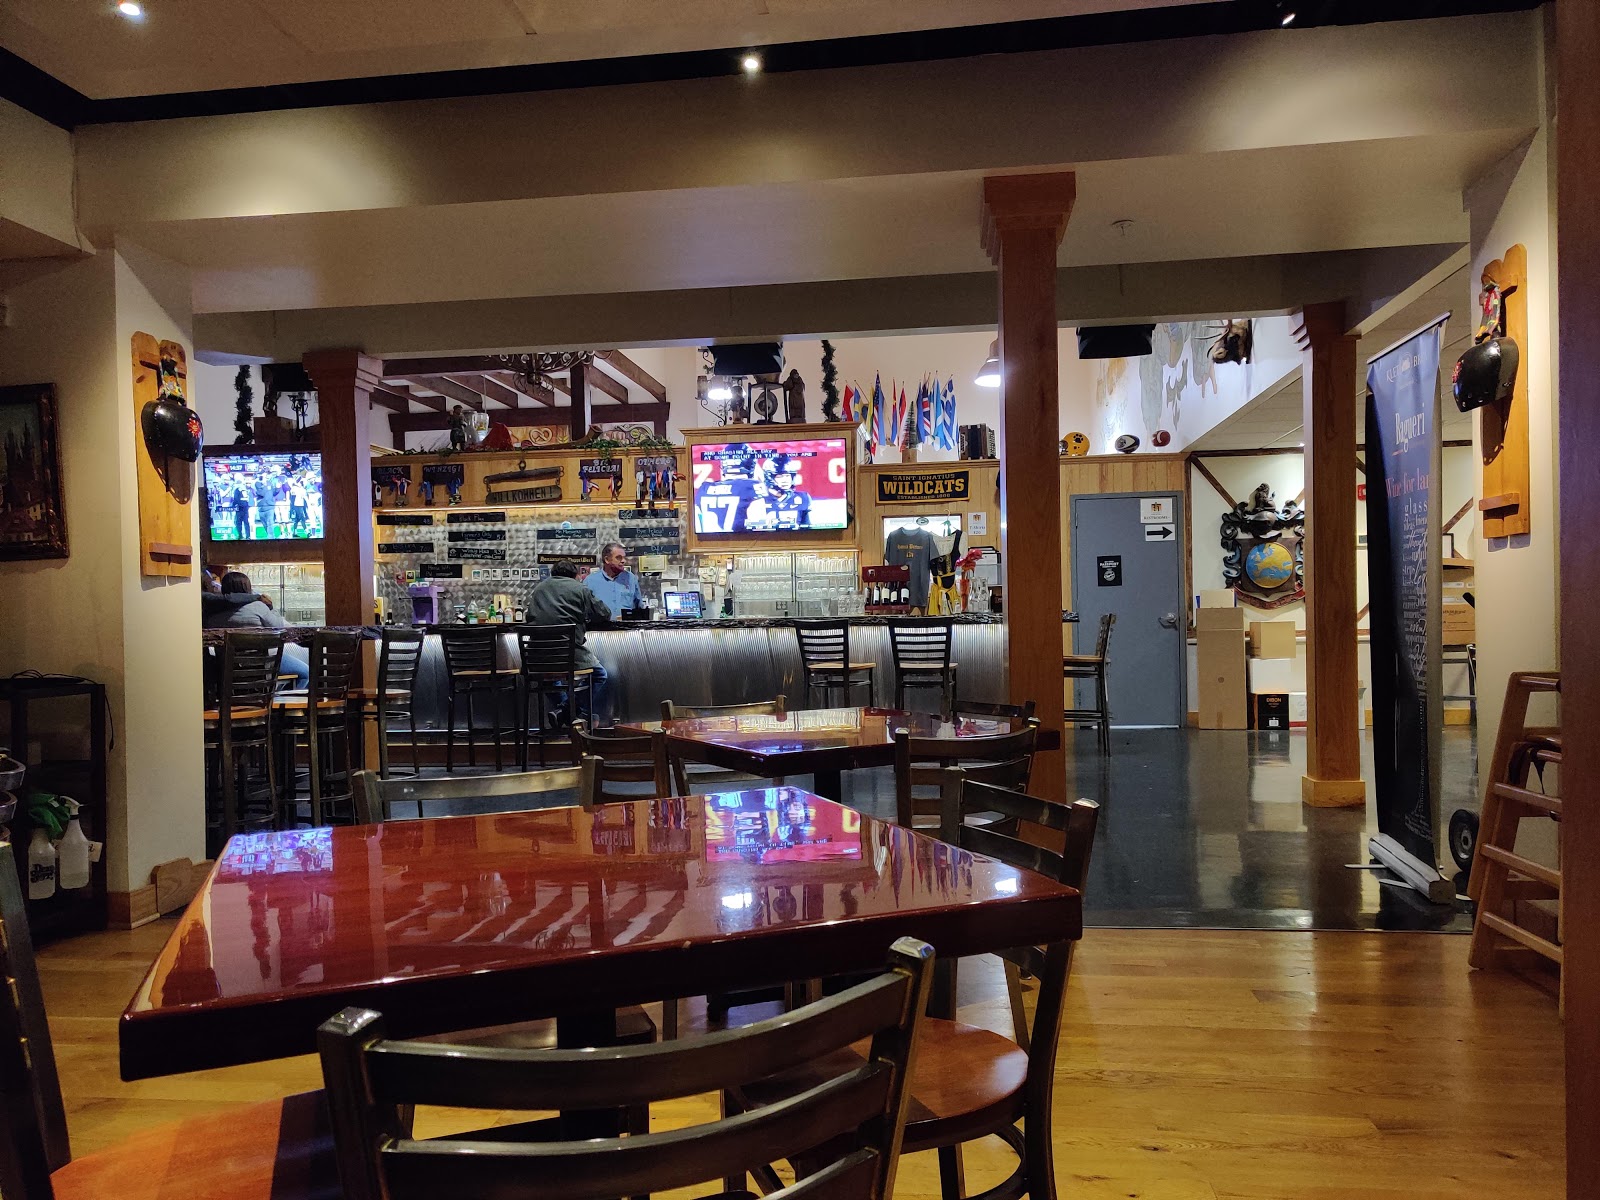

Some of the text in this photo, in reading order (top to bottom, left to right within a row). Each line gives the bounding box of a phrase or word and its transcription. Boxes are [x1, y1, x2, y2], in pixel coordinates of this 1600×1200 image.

[1395, 402, 1425, 453] Bagueri
[582, 464, 620, 473] FELICIA!
[883, 478, 965, 495] WILDCATS
